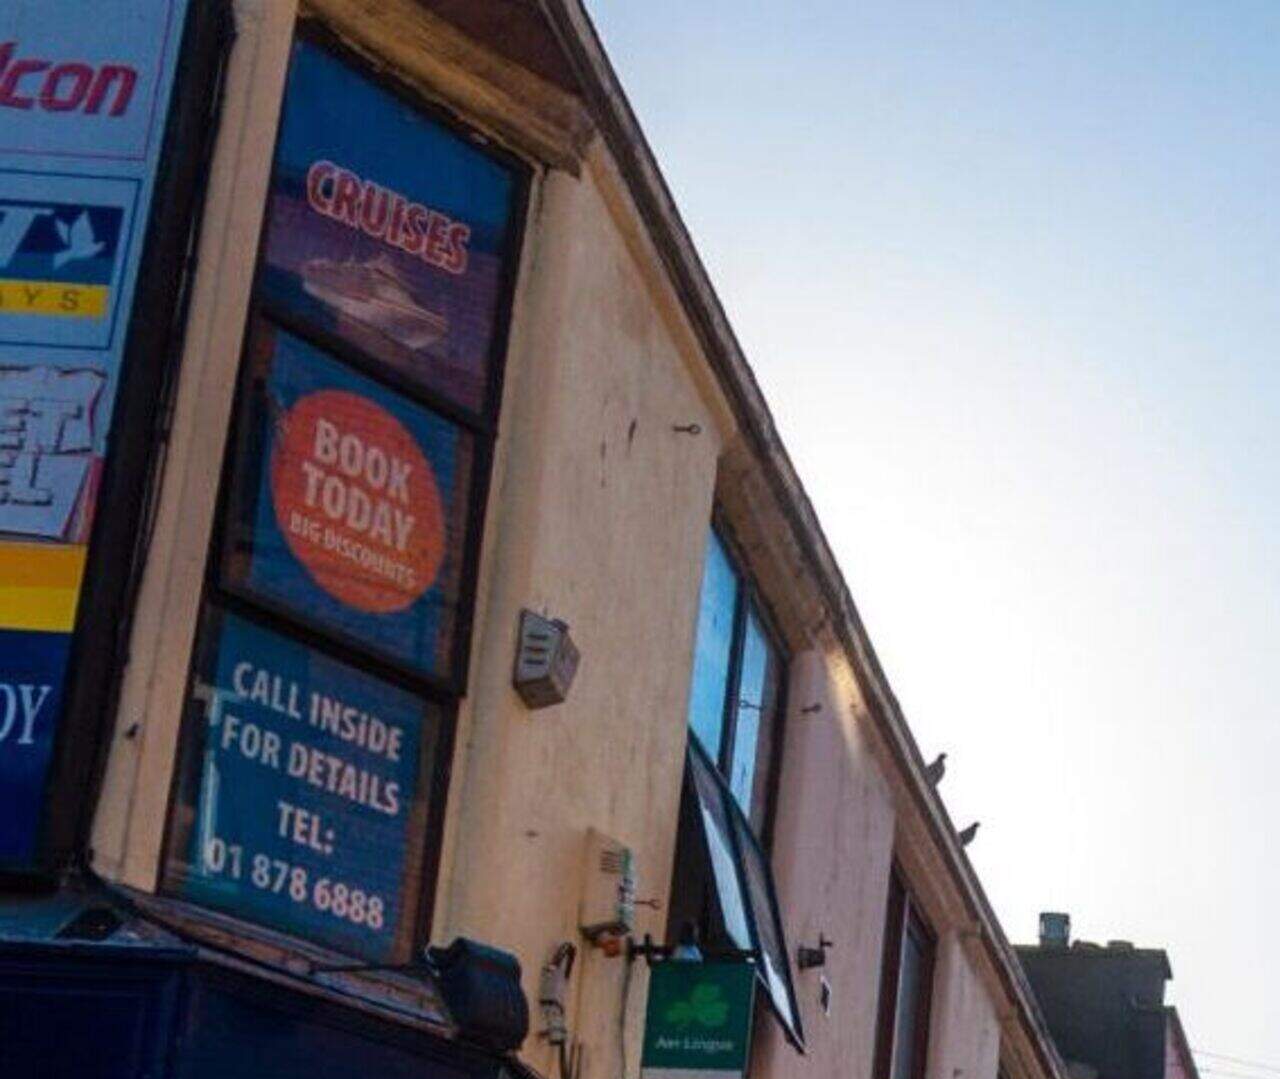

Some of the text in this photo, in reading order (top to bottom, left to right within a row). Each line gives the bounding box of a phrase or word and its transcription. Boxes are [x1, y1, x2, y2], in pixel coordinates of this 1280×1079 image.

[306, 159, 471, 276] CRUISES
[315, 418, 411, 503] BOOK
[290, 511, 321, 543] BIG
[303, 462, 415, 550] TODAY
[232, 662, 301, 719] CALL
[220, 714, 400, 816] FOR DETAILS
[277, 801, 336, 854] TEL:
[204, 838, 384, 930] 01 878 6888
